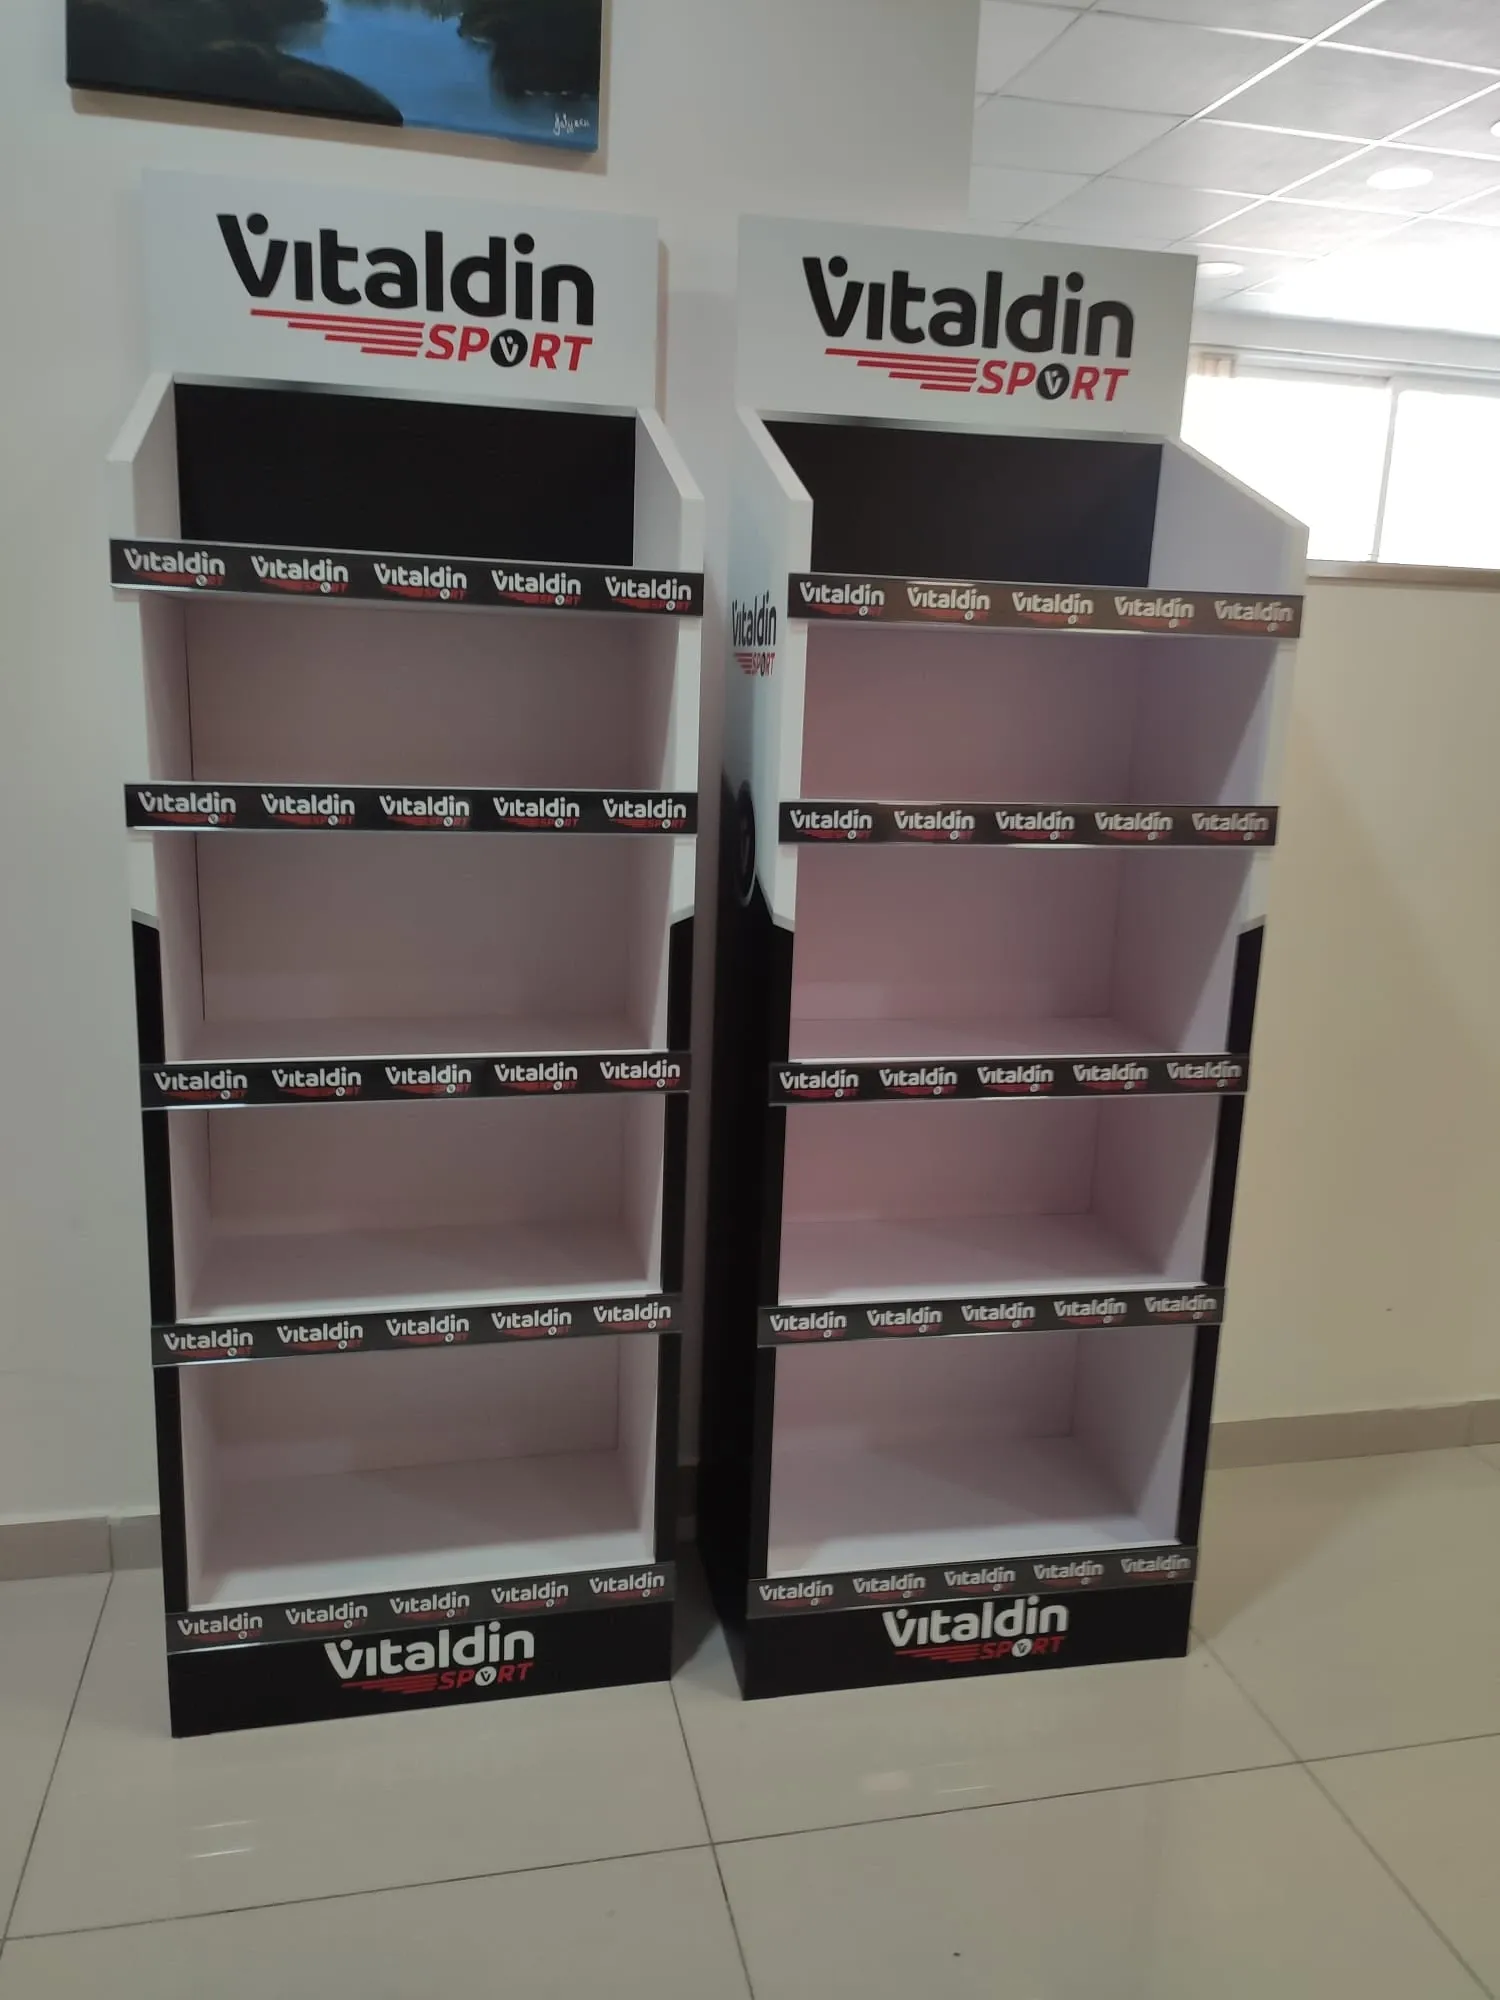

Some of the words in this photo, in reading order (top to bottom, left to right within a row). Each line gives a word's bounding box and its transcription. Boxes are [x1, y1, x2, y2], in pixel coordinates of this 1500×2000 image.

[216, 212, 594, 326] Vitaldin
[802, 255, 1134, 358] Vitaldin
[425, 323, 593, 371] SPORT
[977, 360, 1130, 402] SPORT
[123, 547, 225, 576] Vitaldin
[251, 554, 349, 582] Vitaldin
[373, 562, 467, 589] Vitaldin
[491, 569, 581, 595] Vitaldin
[604, 575, 692, 600] Vitaldin
[732, 590, 777, 647] Vitaldin
[800, 581, 885, 605] Vitaldin
[907, 587, 991, 610] Vitaldin
[1012, 591, 1093, 614] Vitaldin
[1114, 596, 1195, 618] Vitaldin
[1214, 600, 1293, 621] Vitaldin
[138, 792, 236, 813] Vitaldin
[261, 793, 355, 814] Vitaldin
[379, 794, 470, 817] Vitaldin
[493, 797, 580, 817] Vitaldin
[602, 798, 686, 818] Vitaldin
[790, 809, 873, 830] Vitaldin
[894, 810, 975, 830] Vitaldin
[996, 811, 1075, 830] Vitaldin
[1094, 812, 1173, 831] Vitaldin
[1192, 813, 1269, 831] Vitaldin
[153, 1069, 248, 1090] Vitaldin
[272, 1066, 362, 1087] Vitaldin
[385, 1063, 471, 1085] Vitaldin
[494, 1062, 578, 1082] Vitaldin
[600, 1059, 680, 1079] Vitaldin
[779, 1069, 859, 1089] Vitaldin
[879, 1067, 957, 1086] Vitaldin
[977, 1064, 1054, 1083] Vitaldin
[1073, 1062, 1149, 1082] Vitaldin
[1167, 1060, 1242, 1079] Vitaldin
[164, 1328, 253, 1350] Vitaldin
[277, 1321, 363, 1343] Vitaldin
[386, 1314, 469, 1335] Vitaldin
[491, 1308, 572, 1329] Vitaldin
[593, 1302, 671, 1323] Vitaldin
[770, 1311, 847, 1332] Vitaldin
[866, 1307, 943, 1326] Vitaldin
[961, 1302, 1036, 1321] Vitaldin
[1053, 1298, 1127, 1316] Vitaldin
[1144, 1294, 1217, 1312] Vitaldin
[760, 1581, 833, 1600] Vitaldin
[853, 1573, 926, 1593] Vitaldin
[944, 1567, 1016, 1586] Vitaldin
[1033, 1561, 1104, 1580] Vitaldin
[1121, 1555, 1191, 1573] Vitaldin
[177, 1612, 263, 1636] Vitaldin
[285, 1602, 368, 1625] Vitaldin
[389, 1591, 470, 1614] Vitaldin
[491, 1581, 568, 1604] Vitaldin
[589, 1571, 665, 1594] Vitaldin
[882, 1596, 1069, 1648] Vitaldin
[324, 1621, 535, 1679] Vitaldin
[979, 1636, 1067, 1658] SPORT
[437, 1663, 533, 1687] SPORT
